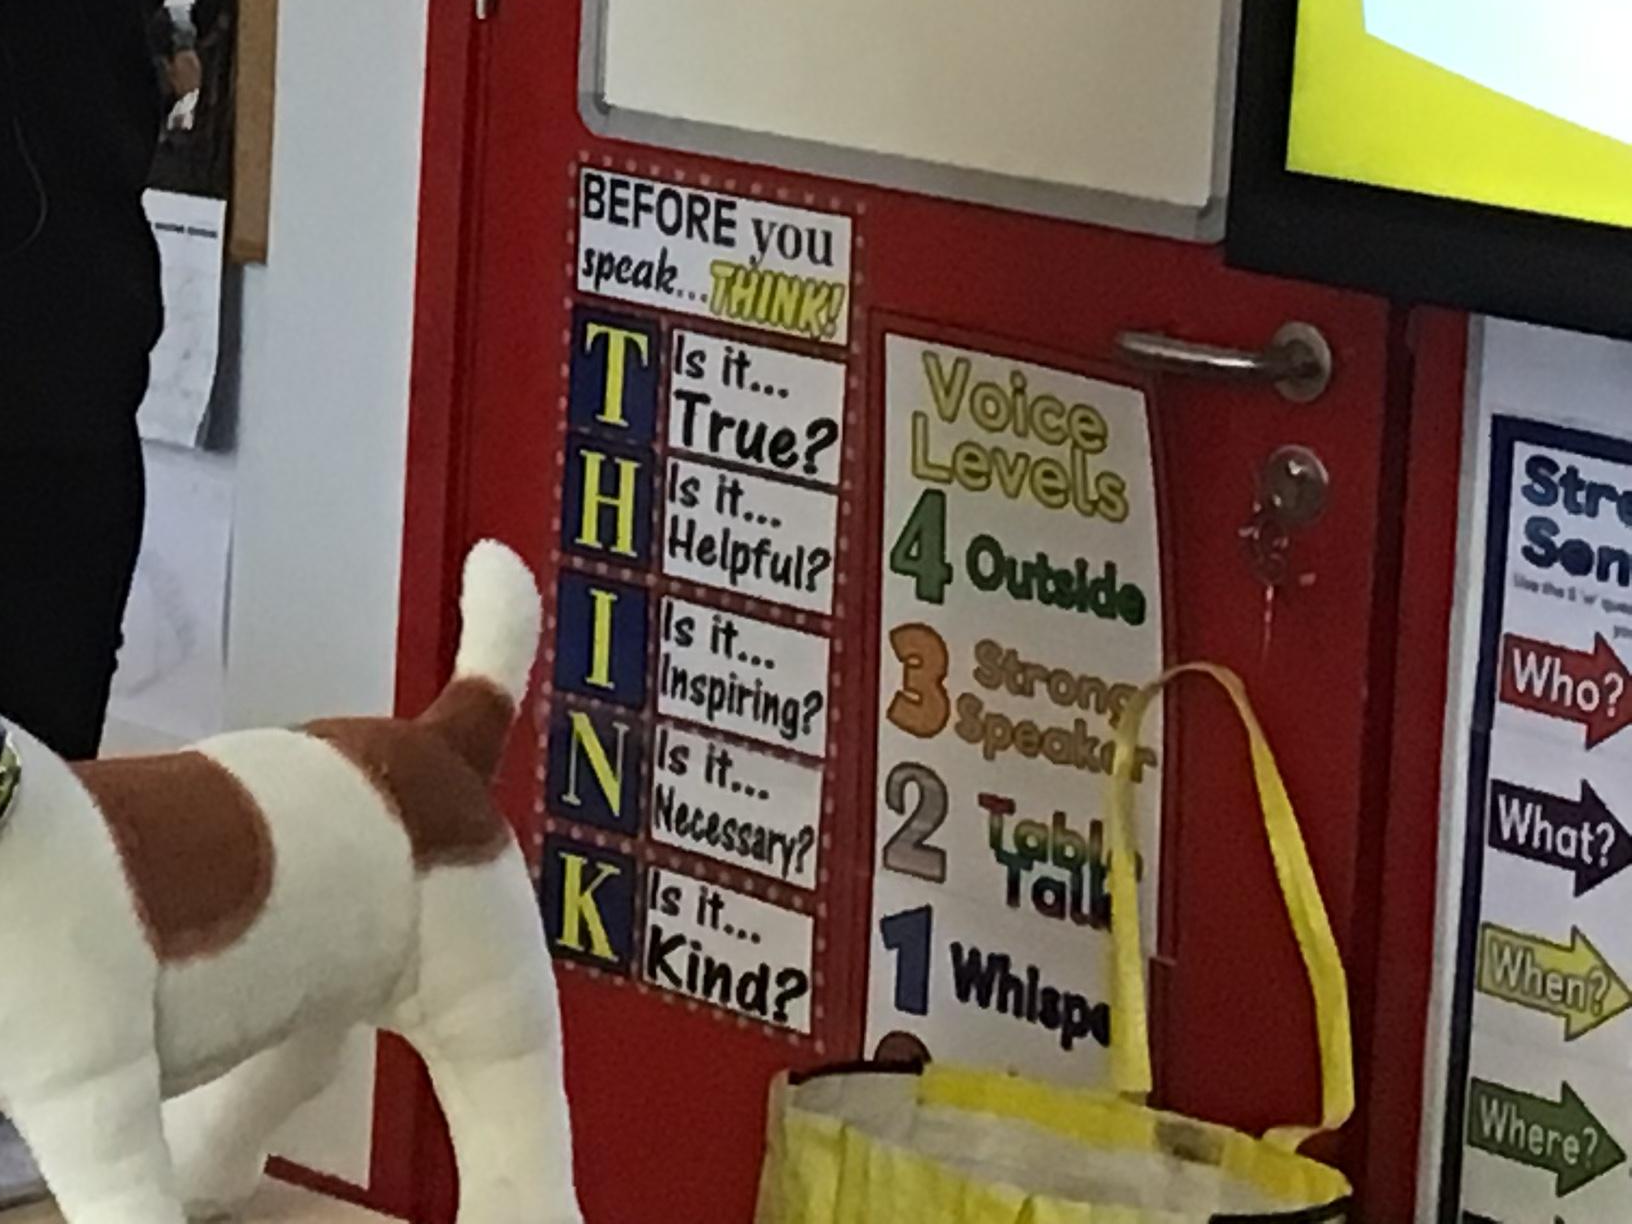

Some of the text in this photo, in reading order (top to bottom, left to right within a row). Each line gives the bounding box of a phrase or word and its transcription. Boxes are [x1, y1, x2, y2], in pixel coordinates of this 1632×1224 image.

[583, 173, 834, 267] BEFORE you
[710, 259, 845, 341] THINK!
[673, 335, 789, 398] Is it...
[922, 351, 1108, 454] Voice
[674, 388, 838, 475] True?
[912, 410, 1129, 523] Levels
[669, 463, 782, 528] Is it...
[669, 515, 831, 592] Helpful?
[890, 488, 1146, 626] 4 Outside
[664, 601, 775, 669] Is it...
[662, 653, 823, 741] Inspiring?
[886, 622, 1139, 737] 3 Strong
[1511, 648, 1624, 717] Who?
[658, 729, 769, 800] Is it...
[655, 783, 815, 880] Necessary?
[885, 761, 948, 884] 2
[1498, 794, 1616, 867] What?
[651, 870, 761, 944] Is it...
[647, 924, 808, 1022] Kind?
[879, 904, 1112, 1052] 1 Whispe
[1490, 938, 1609, 1016] When?
[1479, 1094, 1598, 1167] Where?
